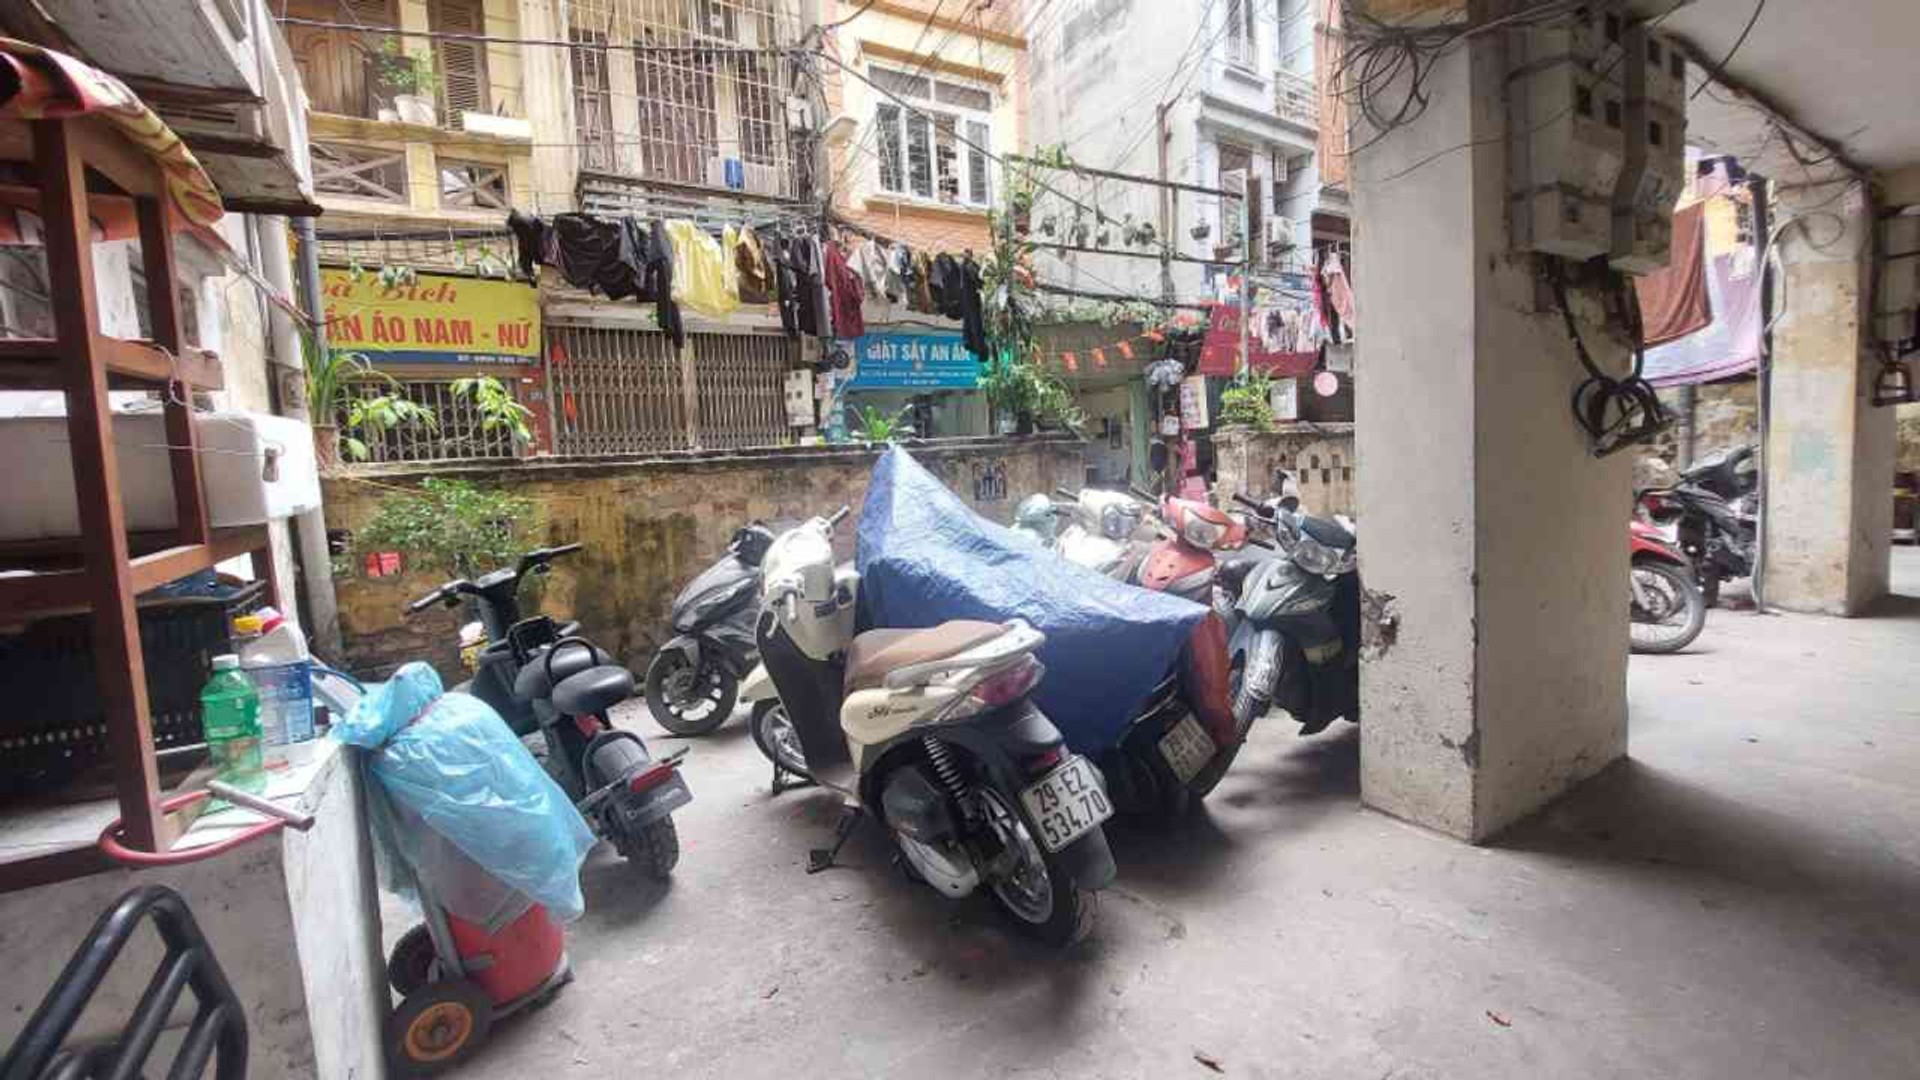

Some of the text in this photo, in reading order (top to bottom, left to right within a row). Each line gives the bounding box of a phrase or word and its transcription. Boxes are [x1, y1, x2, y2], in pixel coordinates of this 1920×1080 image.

[372, 310, 407, 343] ÁO
[413, 317, 474, 345] NAM
[497, 317, 532, 348] NỮ
[1032, 766, 1089, 814] 29-E2
[1042, 790, 1107, 843] 534.70
